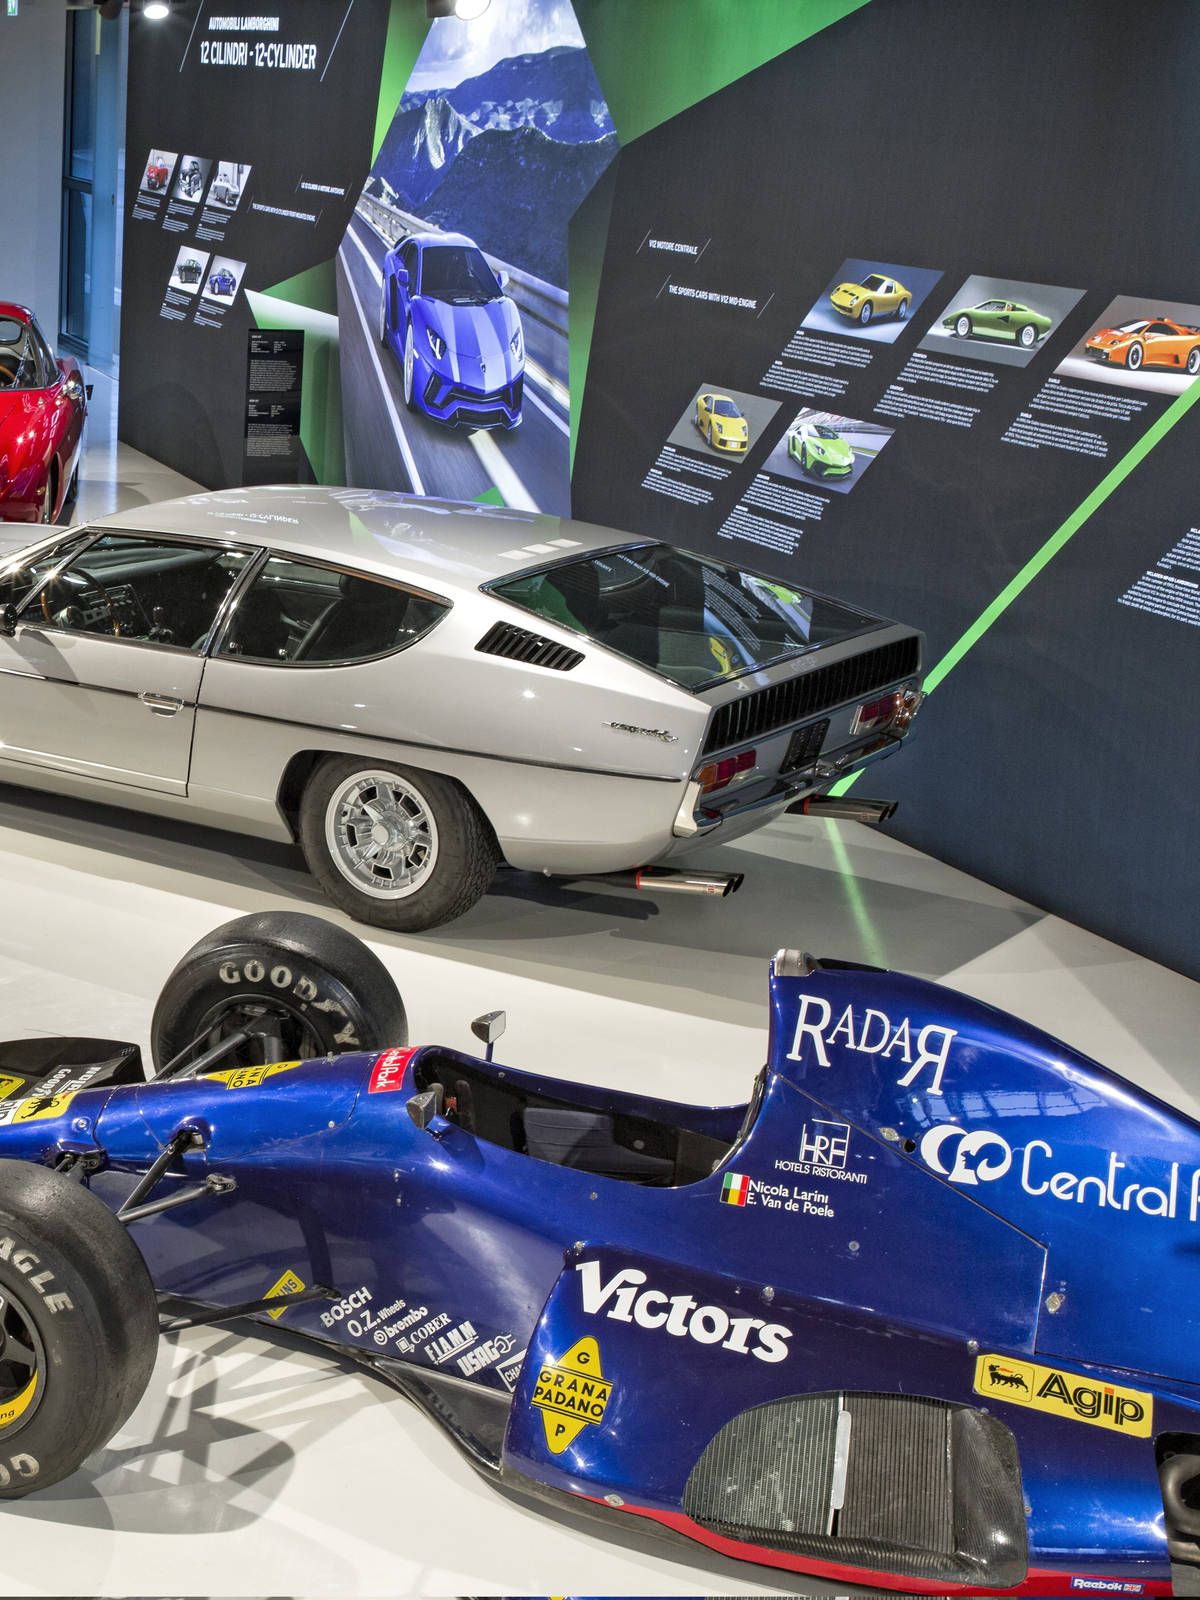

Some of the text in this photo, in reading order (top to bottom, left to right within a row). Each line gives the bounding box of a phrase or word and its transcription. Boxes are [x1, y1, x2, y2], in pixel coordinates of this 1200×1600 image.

[200, 40, 317, 70] 12 CILINDRI 12-CYLINDER
[786, 993, 958, 1096] RADAR
[774, 1160, 868, 1185] HOTELS RISTORANTI
[1021, 1139, 1179, 1219] Central
[746, 1193, 835, 1218] E. Van de Poele
[748, 1180, 829, 1204] Nicola Larini
[319, 1285, 373, 1328] BOSCH
[377, 1298, 407, 1321] Wheels
[384, 1304, 429, 1339] brembo
[575, 1258, 794, 1365] Victors
[411, 1312, 452, 1345] COBER
[424, 1320, 477, 1362] FIAMM
[456, 1338, 497, 1377] USAG
[576, 1351, 591, 1365] G
[533, 1386, 604, 1417] PADANO
[540, 1370, 608, 1402] GRANA
[1035, 1371, 1147, 1426] Agip
[554, 1423, 566, 1437] P
[1073, 1578, 1122, 1591] Reebok
